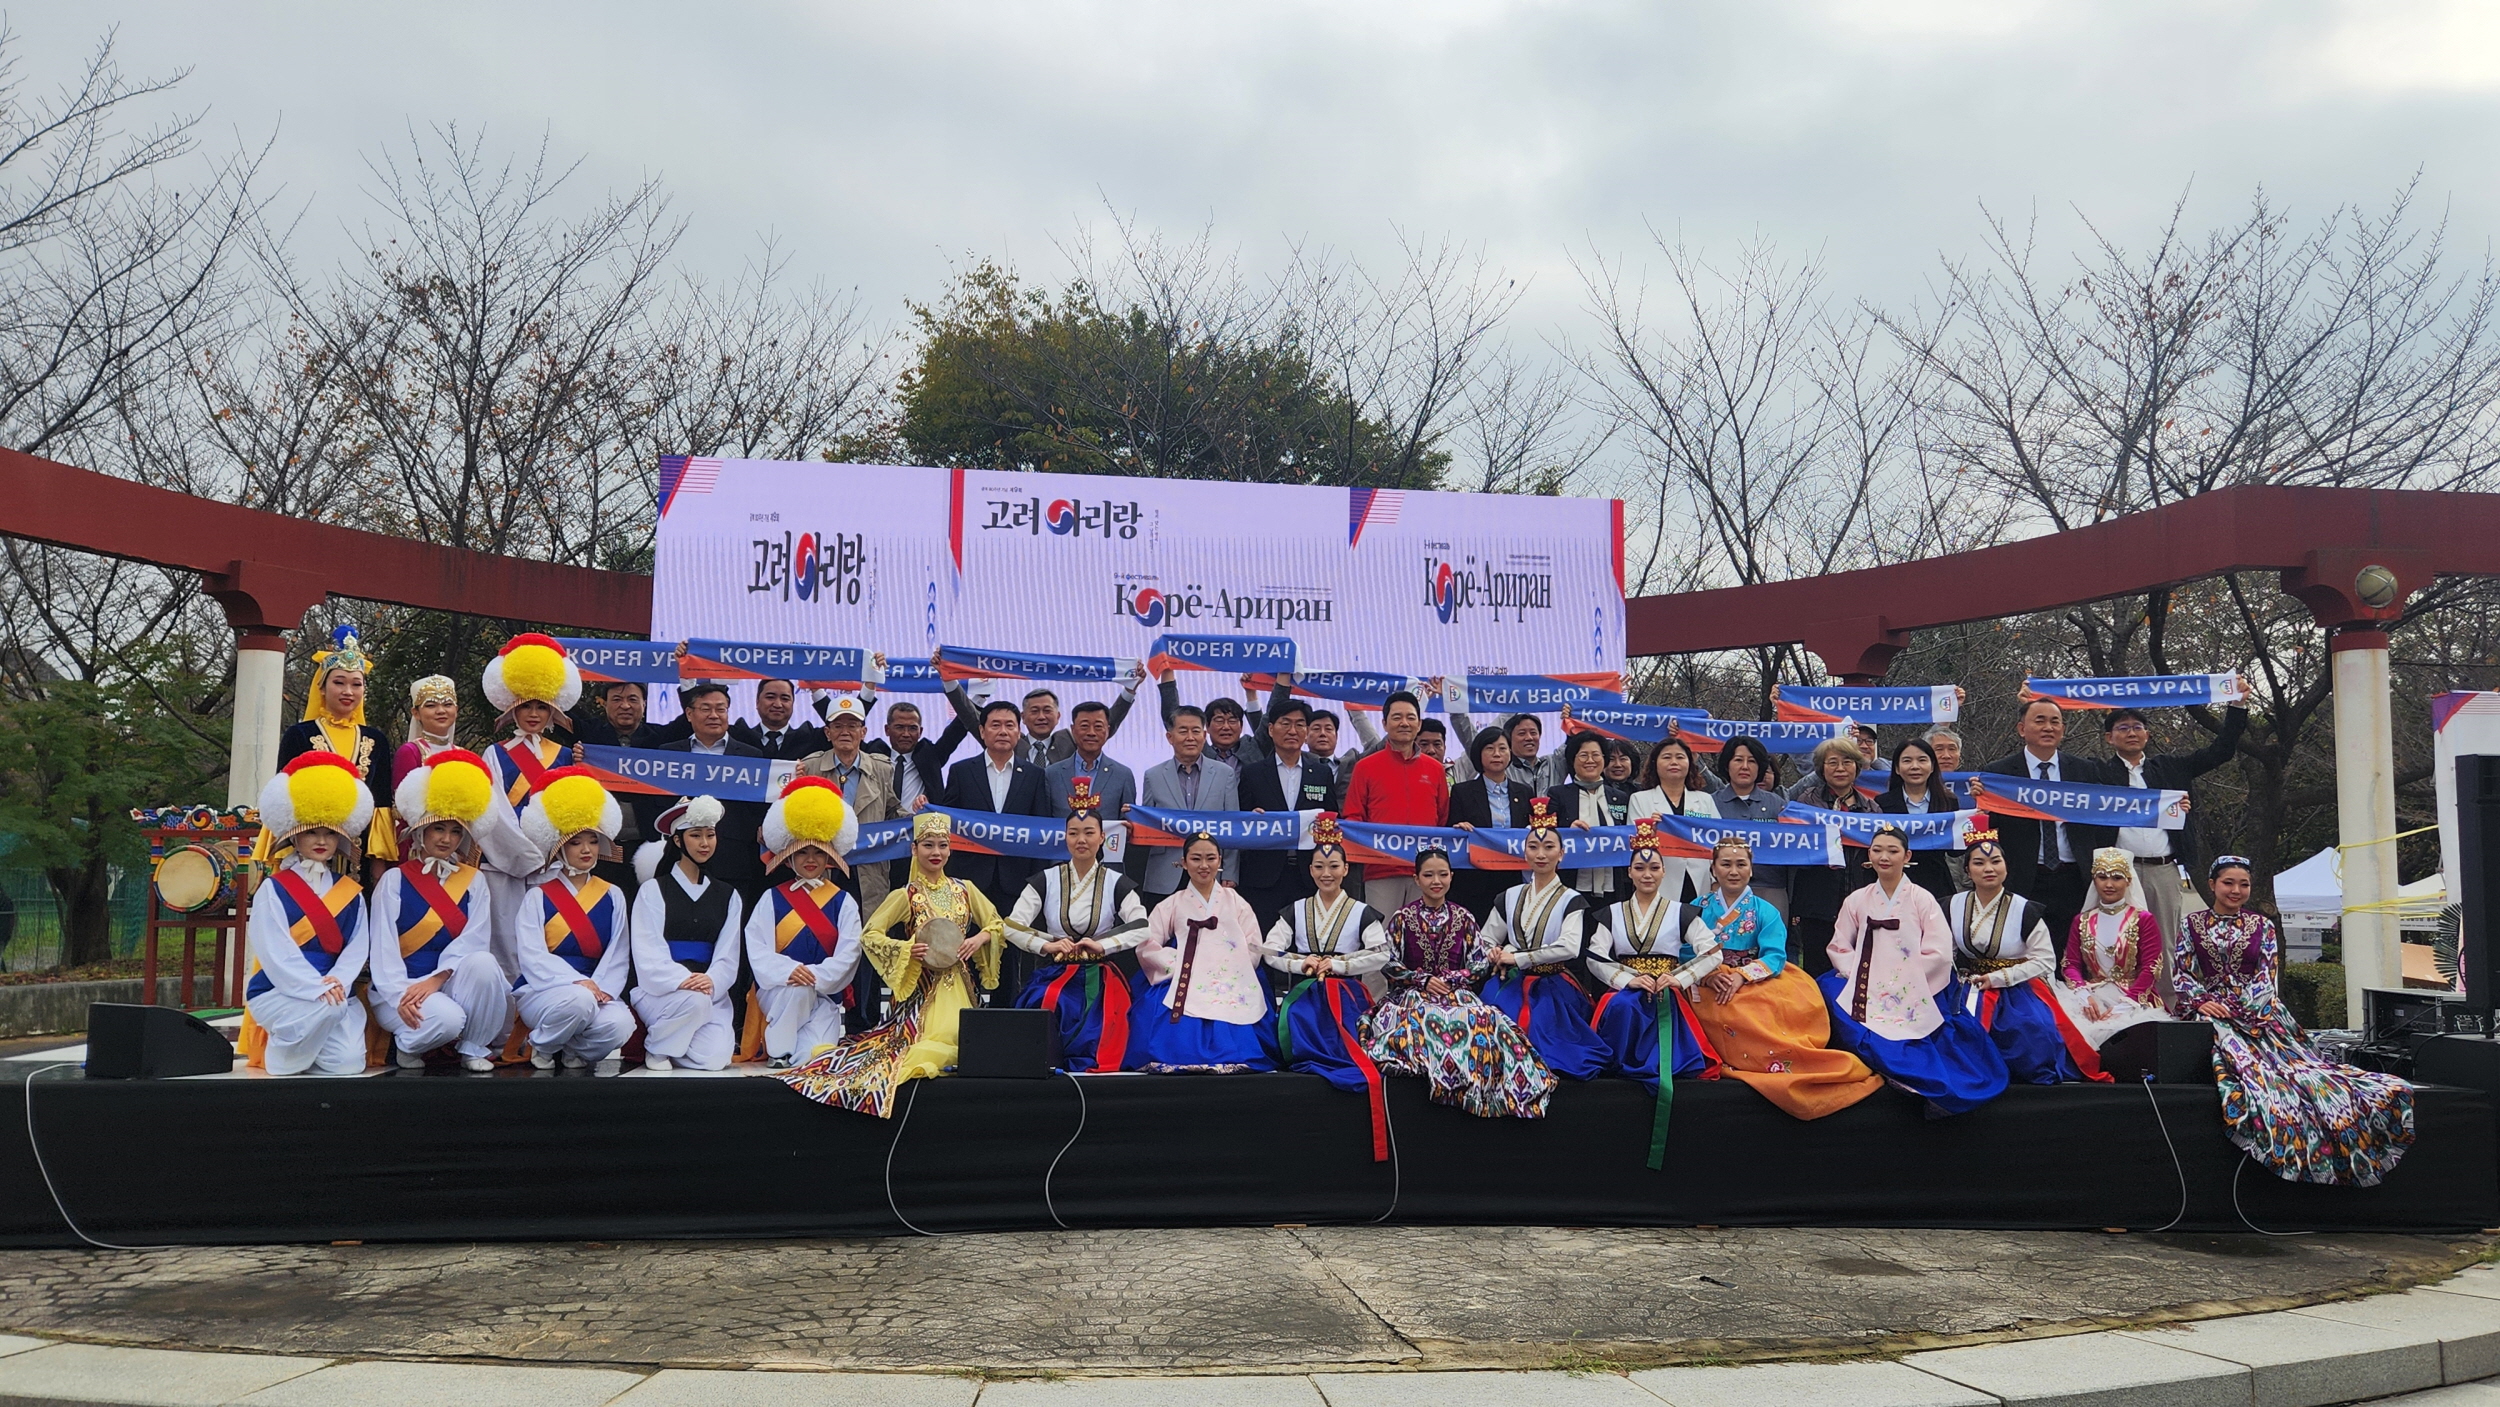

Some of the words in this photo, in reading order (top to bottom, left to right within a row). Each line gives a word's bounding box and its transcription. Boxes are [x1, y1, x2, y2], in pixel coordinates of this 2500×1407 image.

[566, 648, 641, 667] КОРЕЯ
[651, 651, 677, 667] УР
[719, 647, 794, 666] КОРЕЯ
[803, 649, 856, 667] УРА!
[1167, 640, 1234, 658] КОРЕЯ
[1242, 642, 1290, 659] УРА!
[913, 665, 938, 679] УР
[977, 656, 1048, 673] КОРЕЯ
[1057, 664, 1108, 679] УРА!
[1307, 673, 1344, 687] РЕЯ
[1352, 677, 1399, 694] УРА!
[2065, 682, 2140, 698] КОРЕЯ
[2149, 680, 2203, 695] УРА!
[1475, 688, 1519, 704] УРА!
[1528, 687, 1590, 704] КОРЕЯ
[1810, 695, 1872, 711] КОРЕЯ
[1880, 695, 1925, 712] УРА!
[1581, 708, 1647, 727] КОРЕЯ
[1705, 722, 1773, 738] КОРЕЯ
[1780, 723, 1828, 739] УРА!
[617, 757, 696, 780] КОРЕЯ
[705, 764, 762, 787] УРА!
[2016, 786, 2090, 809] КОРЕЯ
[2099, 795, 2152, 815] УРА!
[956, 818, 1030, 844] КОРЕЯ
[1039, 829, 1066, 847] УР
[1160, 816, 1234, 837] КОРЕЯ
[1241, 819, 1293, 837] УРА!
[1815, 811, 1886, 832] КОРЕЯ
[1895, 819, 1947, 836] УРА!
[866, 827, 911, 849] УРА
[1584, 835, 1626, 853] УРА
[1769, 831, 1820, 850] УРА!
